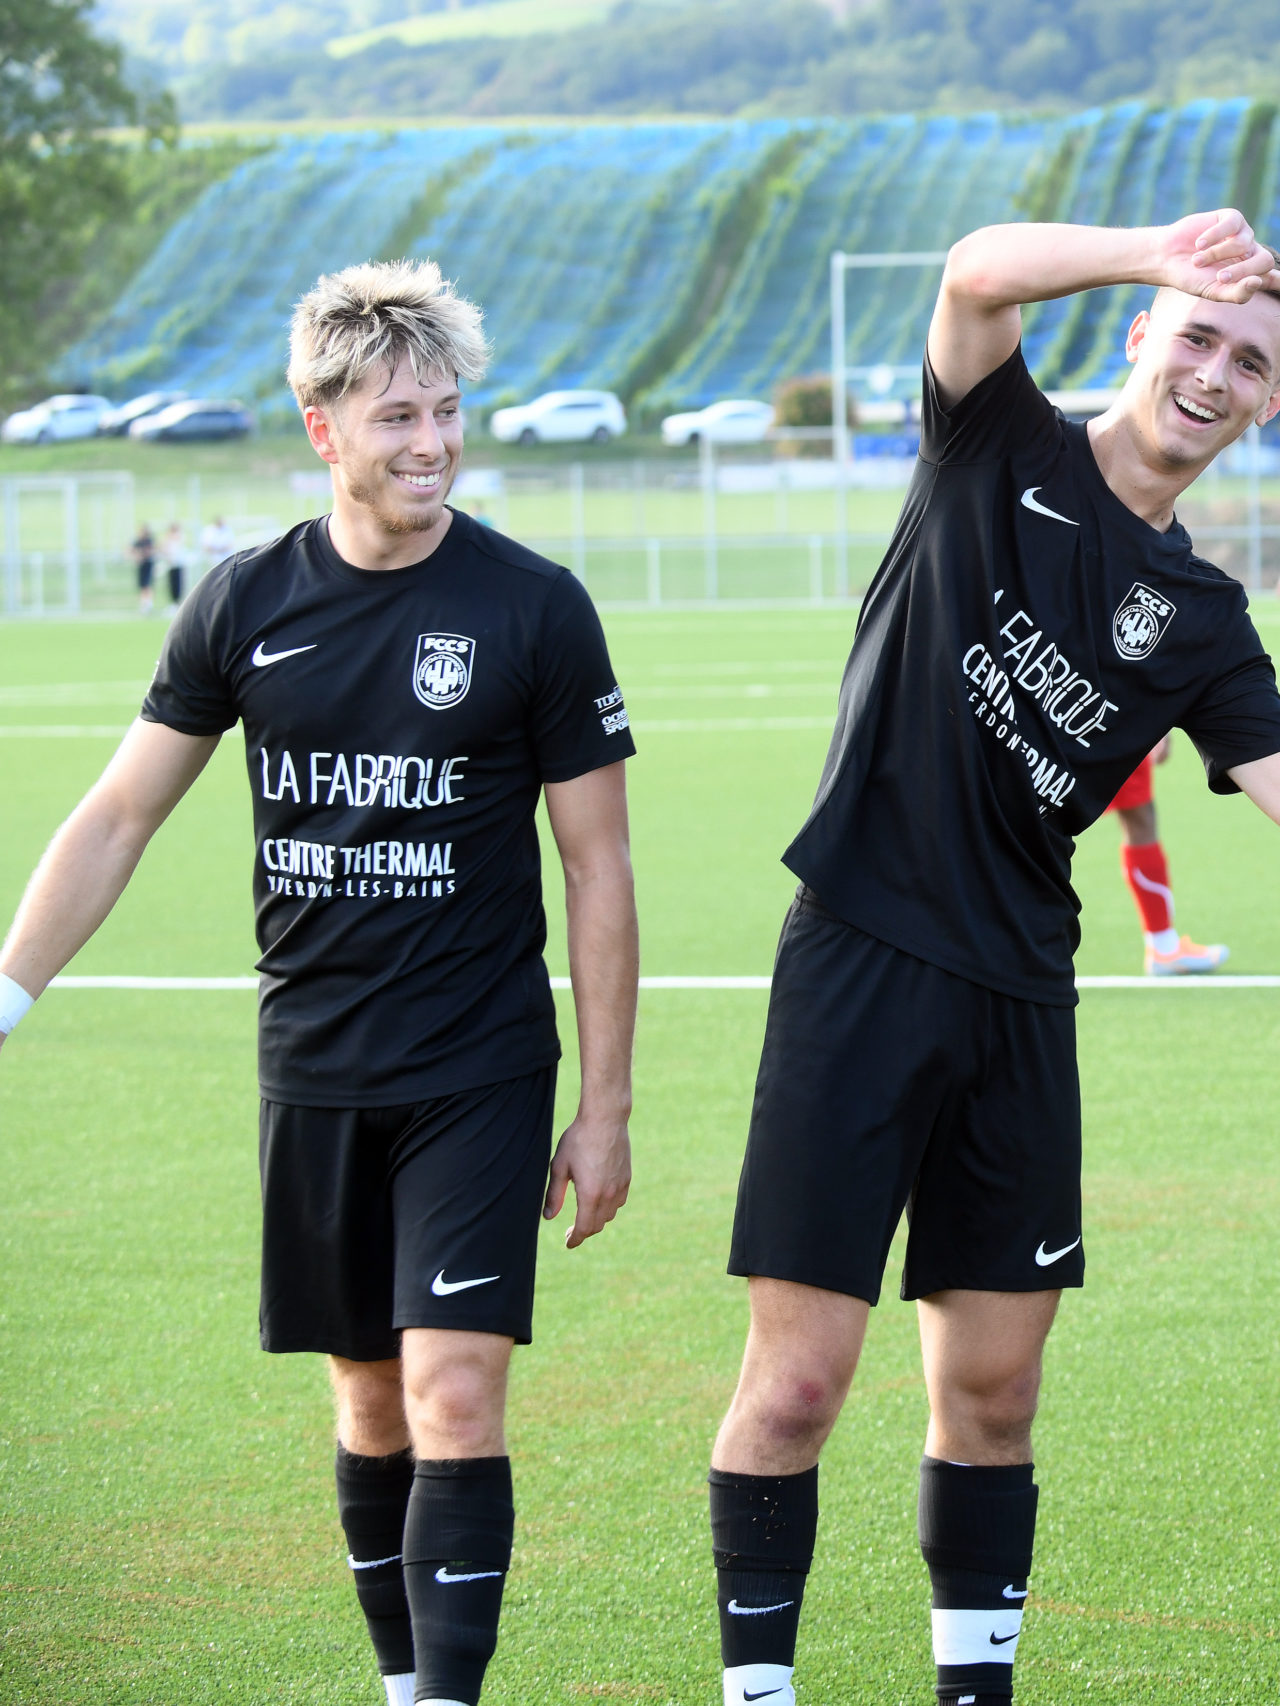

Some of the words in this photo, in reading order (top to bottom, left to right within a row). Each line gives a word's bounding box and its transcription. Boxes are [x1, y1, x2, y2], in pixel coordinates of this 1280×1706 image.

[1134, 588, 1171, 617] FCCS
[424, 637, 470, 654] FCCS
[1000, 610, 1119, 748] FABRIQUE
[260, 747, 301, 804] LA
[310, 752, 469, 809] FABRIQUE
[262, 838, 336, 880] CENTRE
[339, 840, 456, 877] THERMAL
